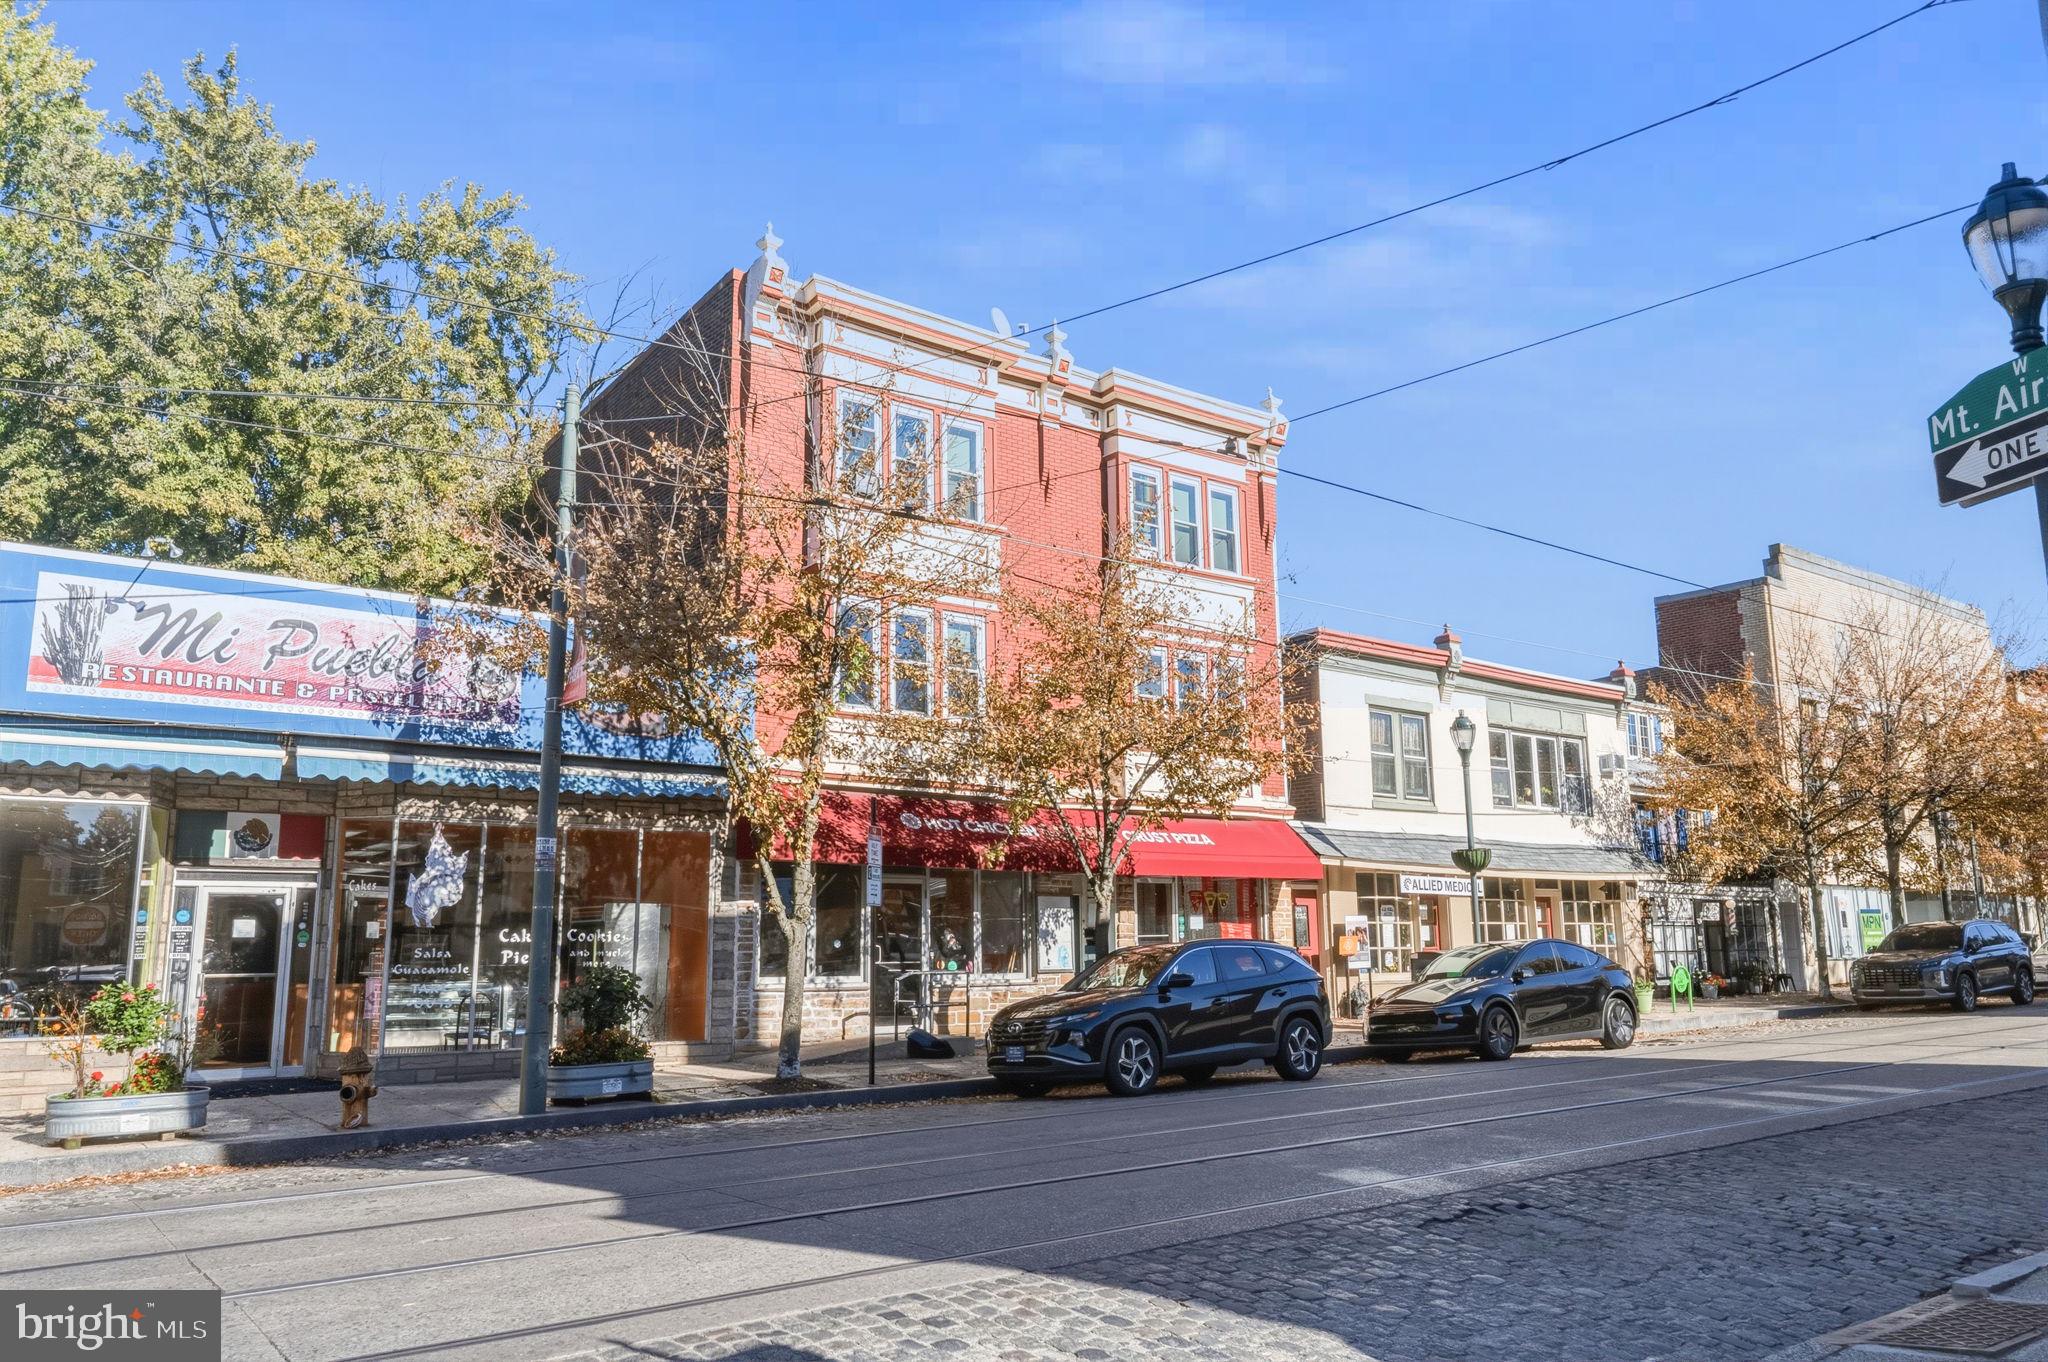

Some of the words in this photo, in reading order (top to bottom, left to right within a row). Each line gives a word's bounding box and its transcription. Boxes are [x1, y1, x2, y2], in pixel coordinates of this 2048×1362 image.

[2012, 356, 2028, 376] W
[1931, 405, 1979, 446] Mt.
[1994, 377, 2048, 421] Air
[1987, 432, 2041, 470] ONE
[137, 602, 240, 665] Mi
[82, 662, 286, 698] RESTAURANTE
[297, 682, 318, 699] &
[923, 817, 962, 832] HOT
[1170, 832, 1216, 846] PIZZA
[348, 879, 377, 892] Cakes
[1412, 878, 1443, 892] ALLIED
[1444, 880, 1483, 894] MEDICL
[499, 928, 532, 943] Cak
[414, 947, 452, 959] Salsa
[393, 963, 470, 975] Guacamole
